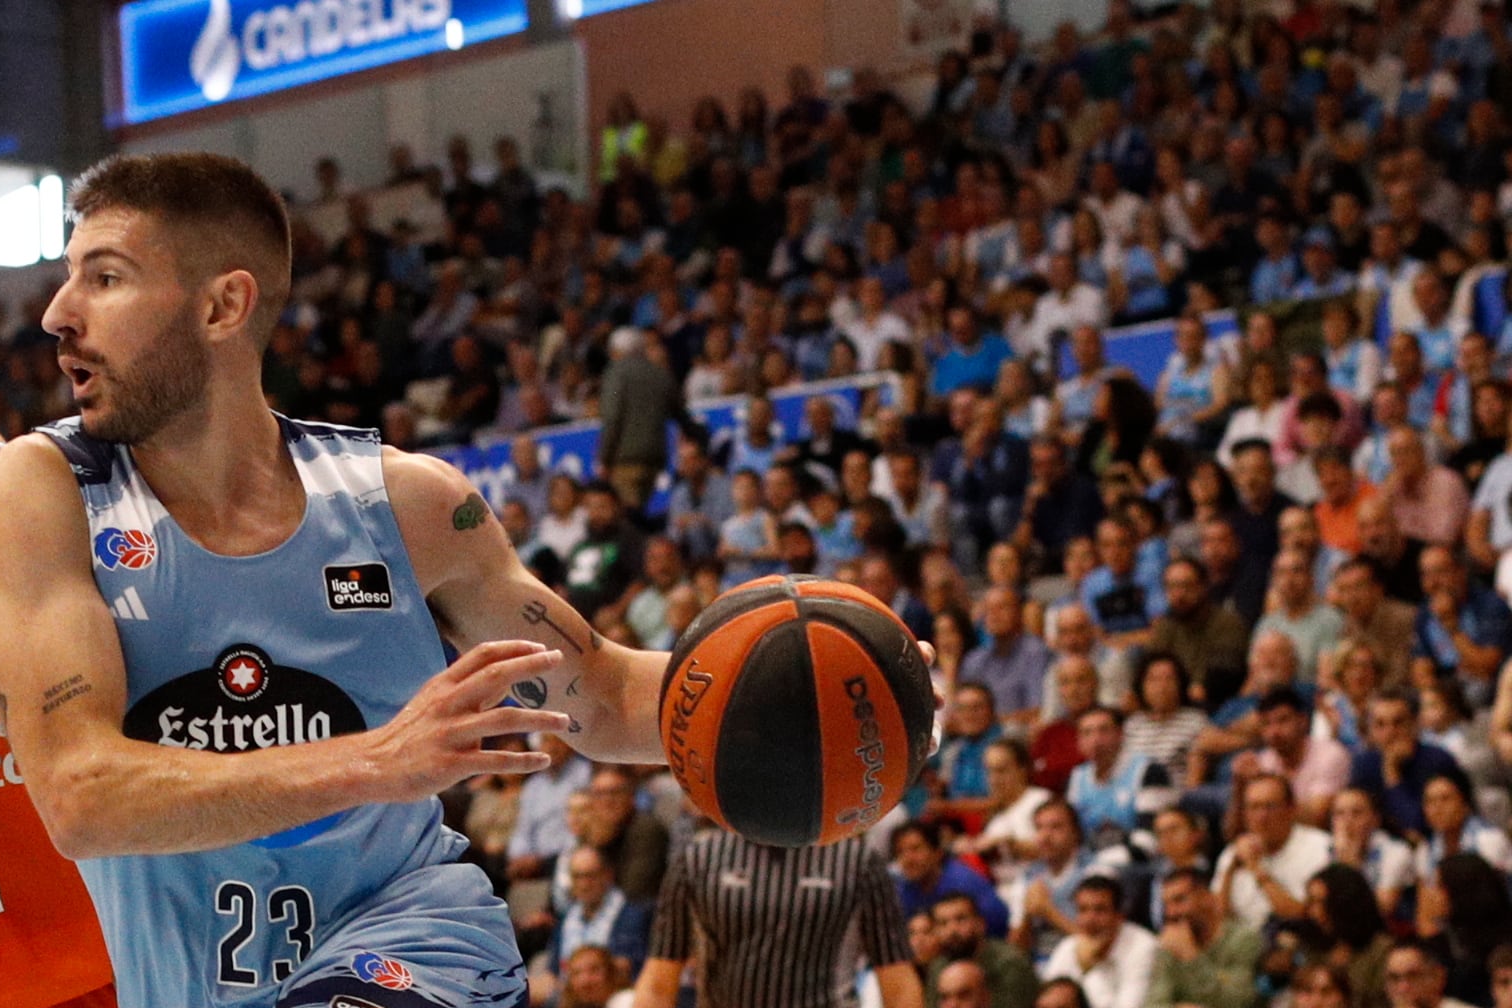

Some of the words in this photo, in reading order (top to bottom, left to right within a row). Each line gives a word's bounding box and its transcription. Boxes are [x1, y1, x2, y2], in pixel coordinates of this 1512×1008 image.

[331, 578, 360, 593] liga
[334, 590, 390, 604] endesa
[158, 703, 331, 751] Estrella
[215, 880, 314, 987] 23
